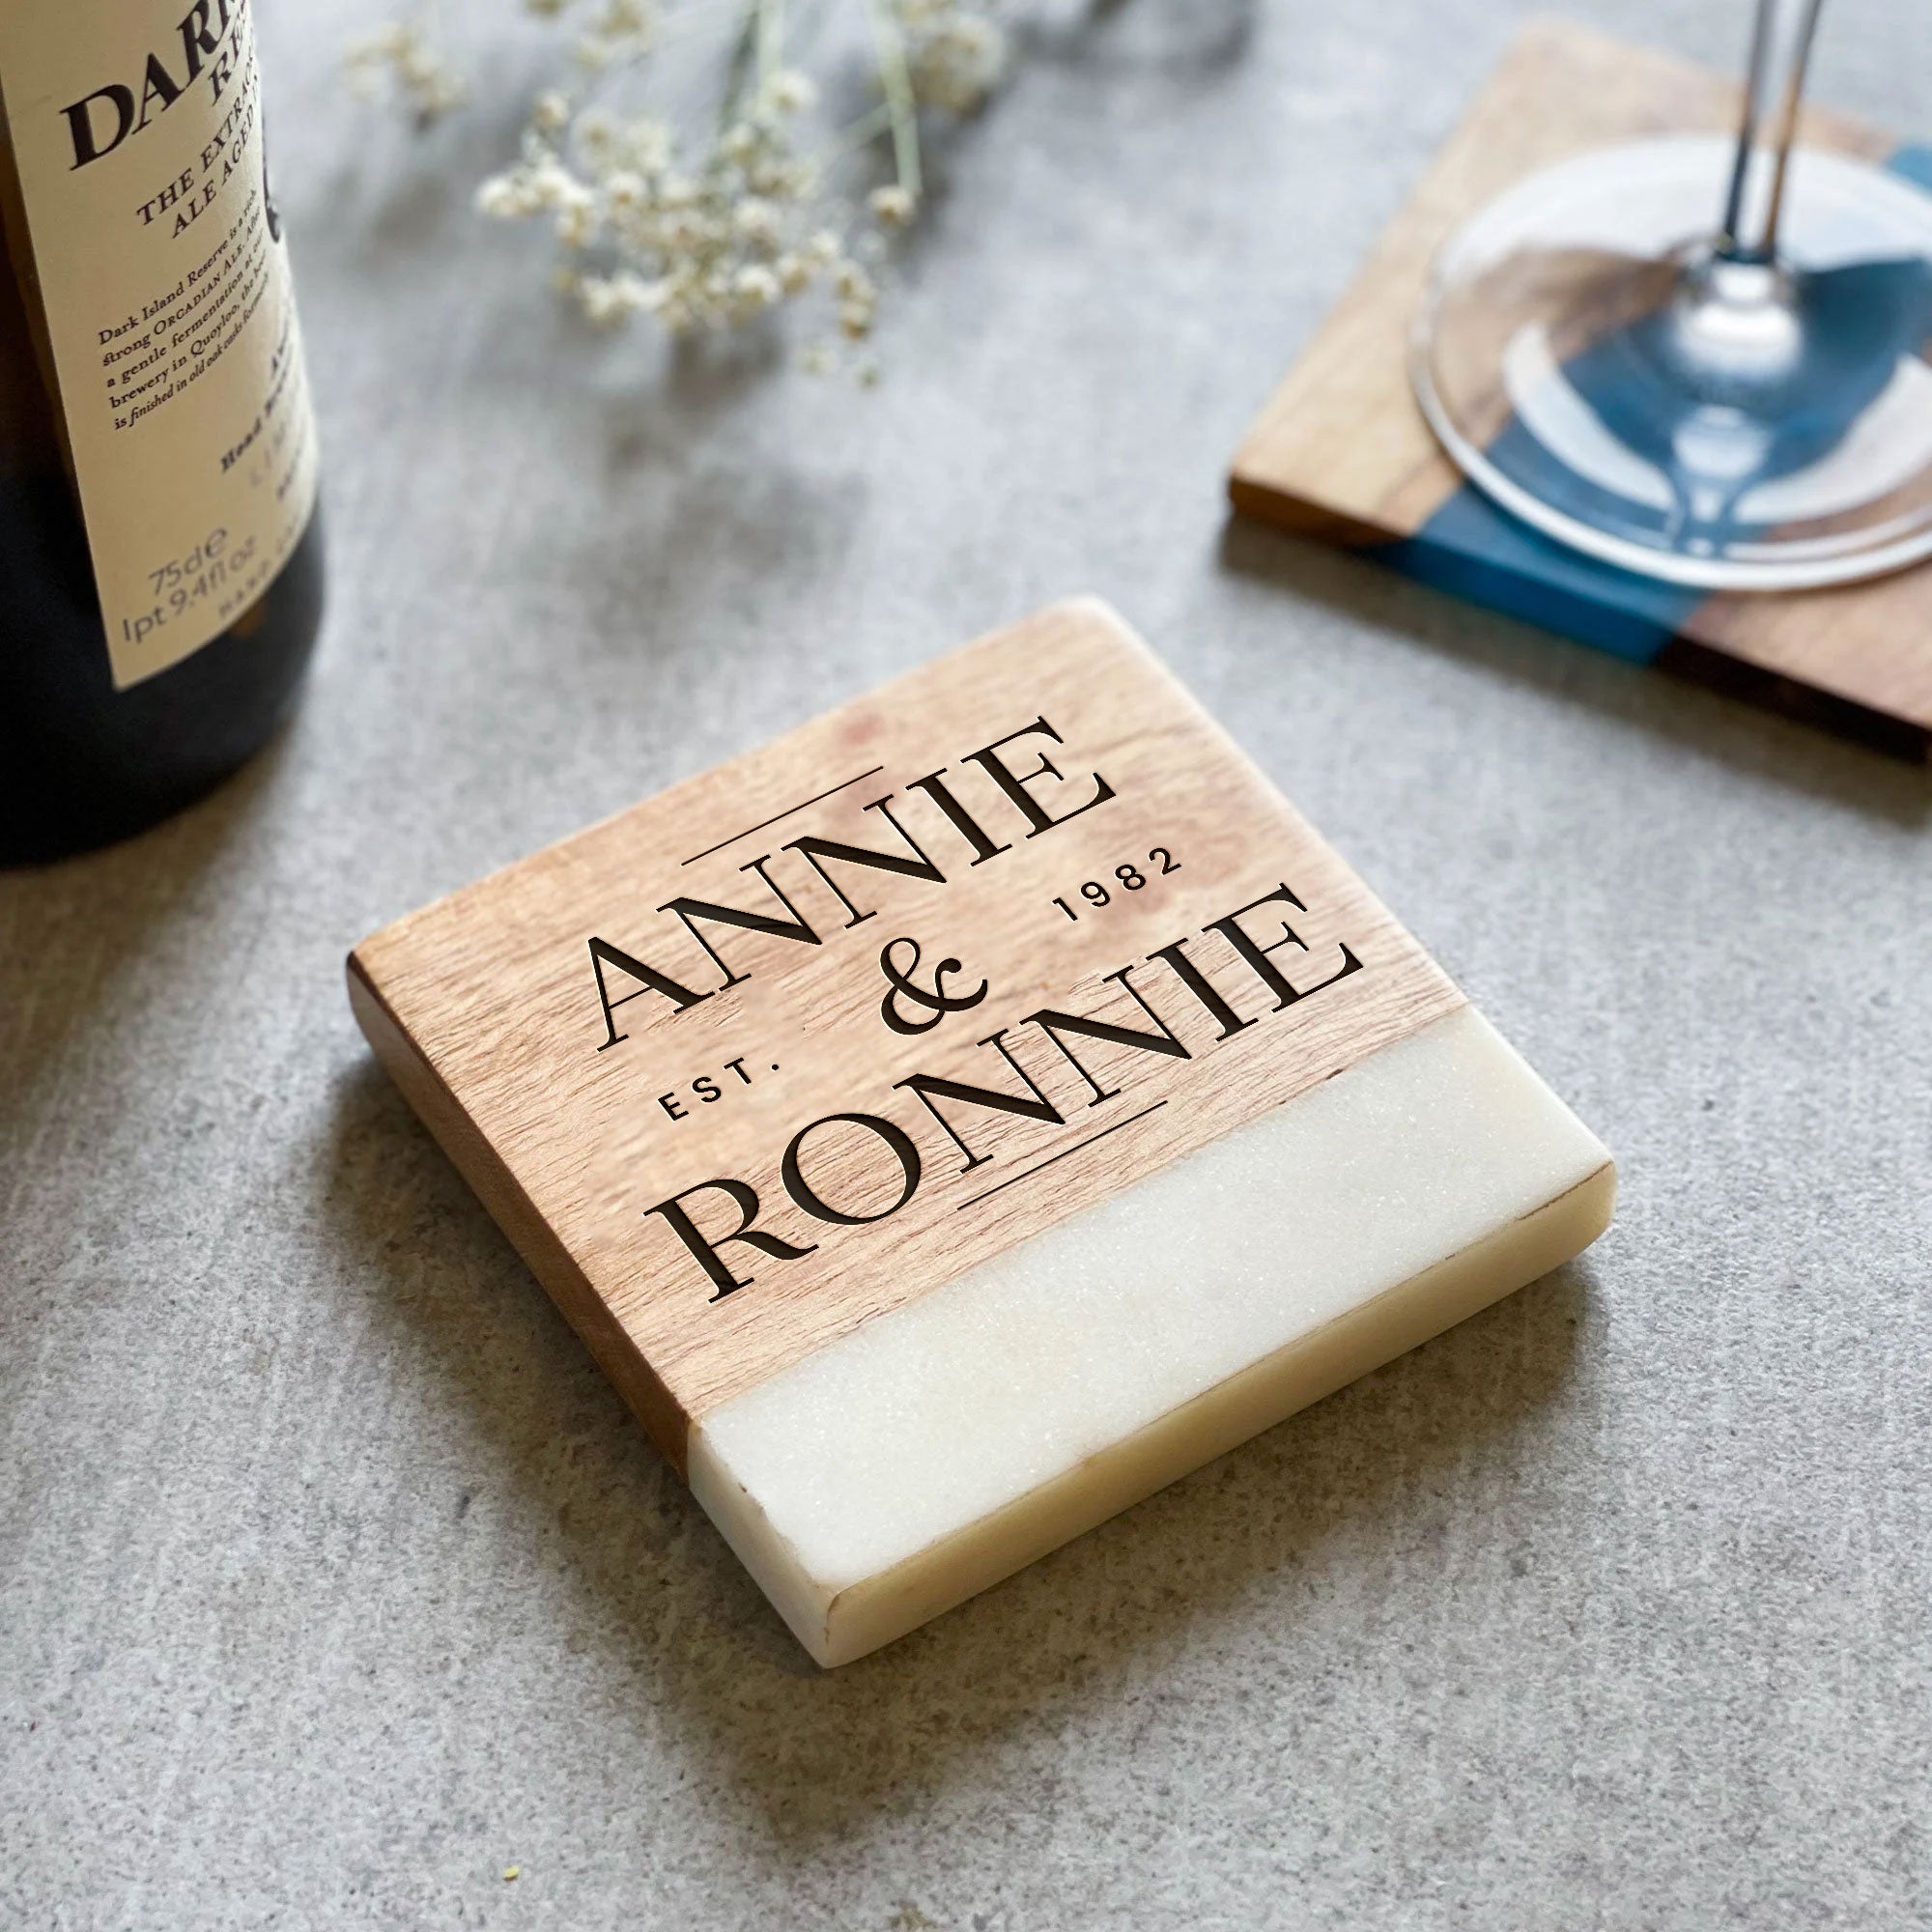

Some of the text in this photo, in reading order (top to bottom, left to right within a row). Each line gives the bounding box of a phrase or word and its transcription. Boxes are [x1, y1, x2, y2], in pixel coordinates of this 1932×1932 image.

[136, 167, 194, 225] THE
[172, 103, 253, 239] ALE AGED
[99, 315, 139, 346] Dark
[142, 281, 185, 322] Island
[186, 240, 228, 288] Reserve
[230, 226, 238, 240] is
[102, 333, 151, 367] strong
[154, 271, 221, 336] ORCADIAN
[106, 378, 116, 388] a
[122, 347, 167, 384] gentle
[171, 270, 243, 348] fermentation
[108, 368, 170, 410] brewery
[172, 355, 187, 372] in
[114, 416, 128, 431] is
[128, 384, 174, 428] finished
[177, 378, 188, 392] in
[188, 358, 206, 383] old
[207, 344, 223, 367] oak
[585, 716, 1116, 1052] ANNIE
[658, 847, 1182, 1122] EST. & 1982
[643, 883, 1364, 1304] RONNIE
